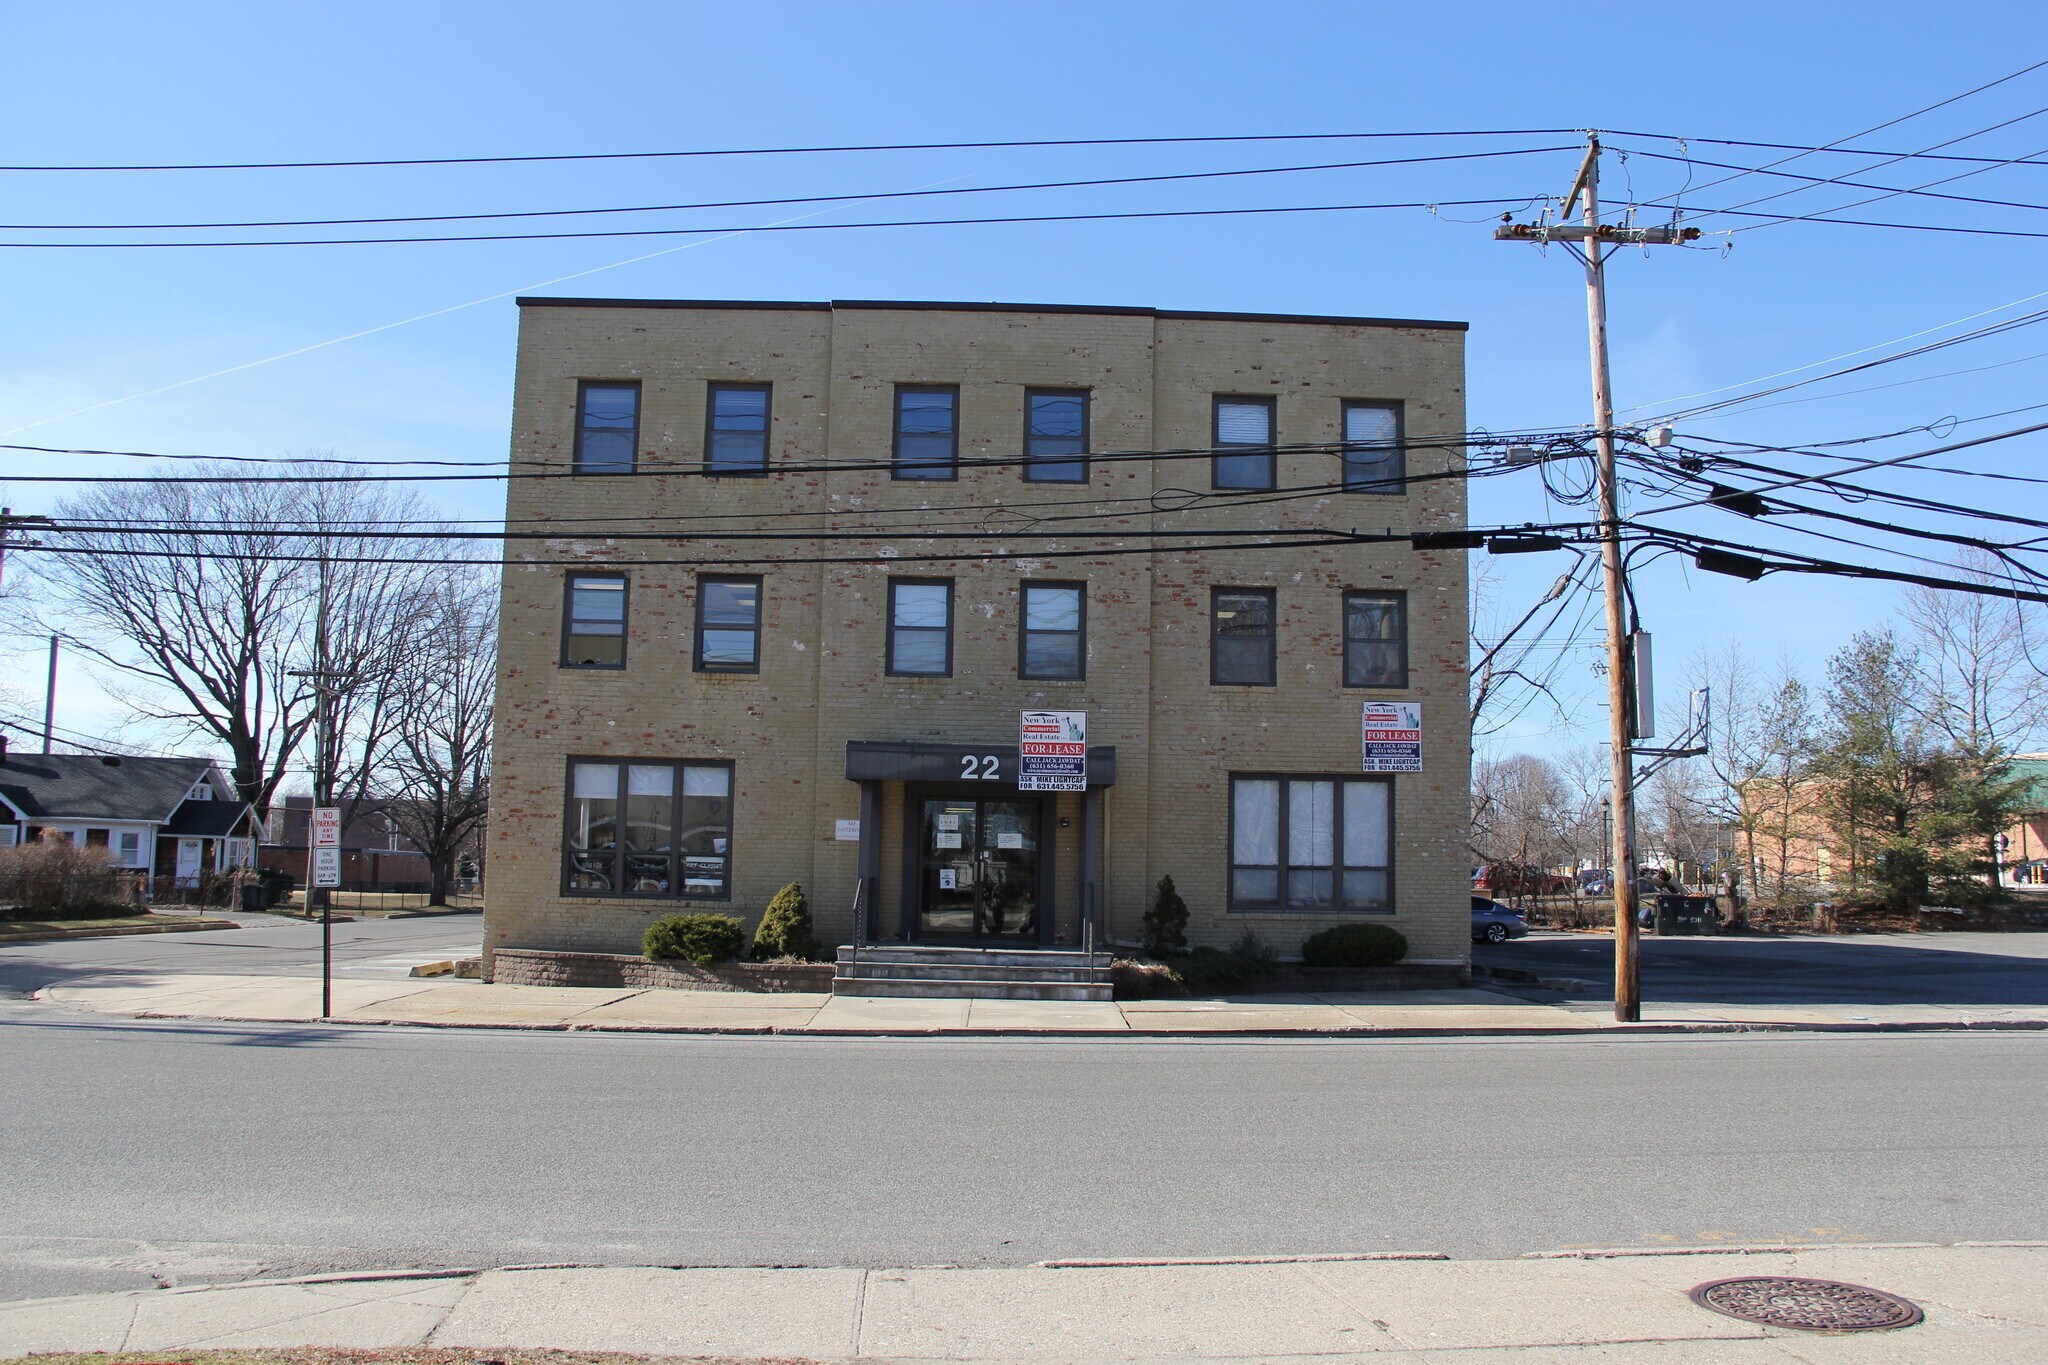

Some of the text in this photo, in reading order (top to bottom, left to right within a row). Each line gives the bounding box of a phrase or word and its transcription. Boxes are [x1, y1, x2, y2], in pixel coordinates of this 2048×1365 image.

[1366, 731, 1418, 740] FOR LEASE
[1024, 744, 1082, 754] FOR LEASE
[960, 755, 1000, 780] 22
